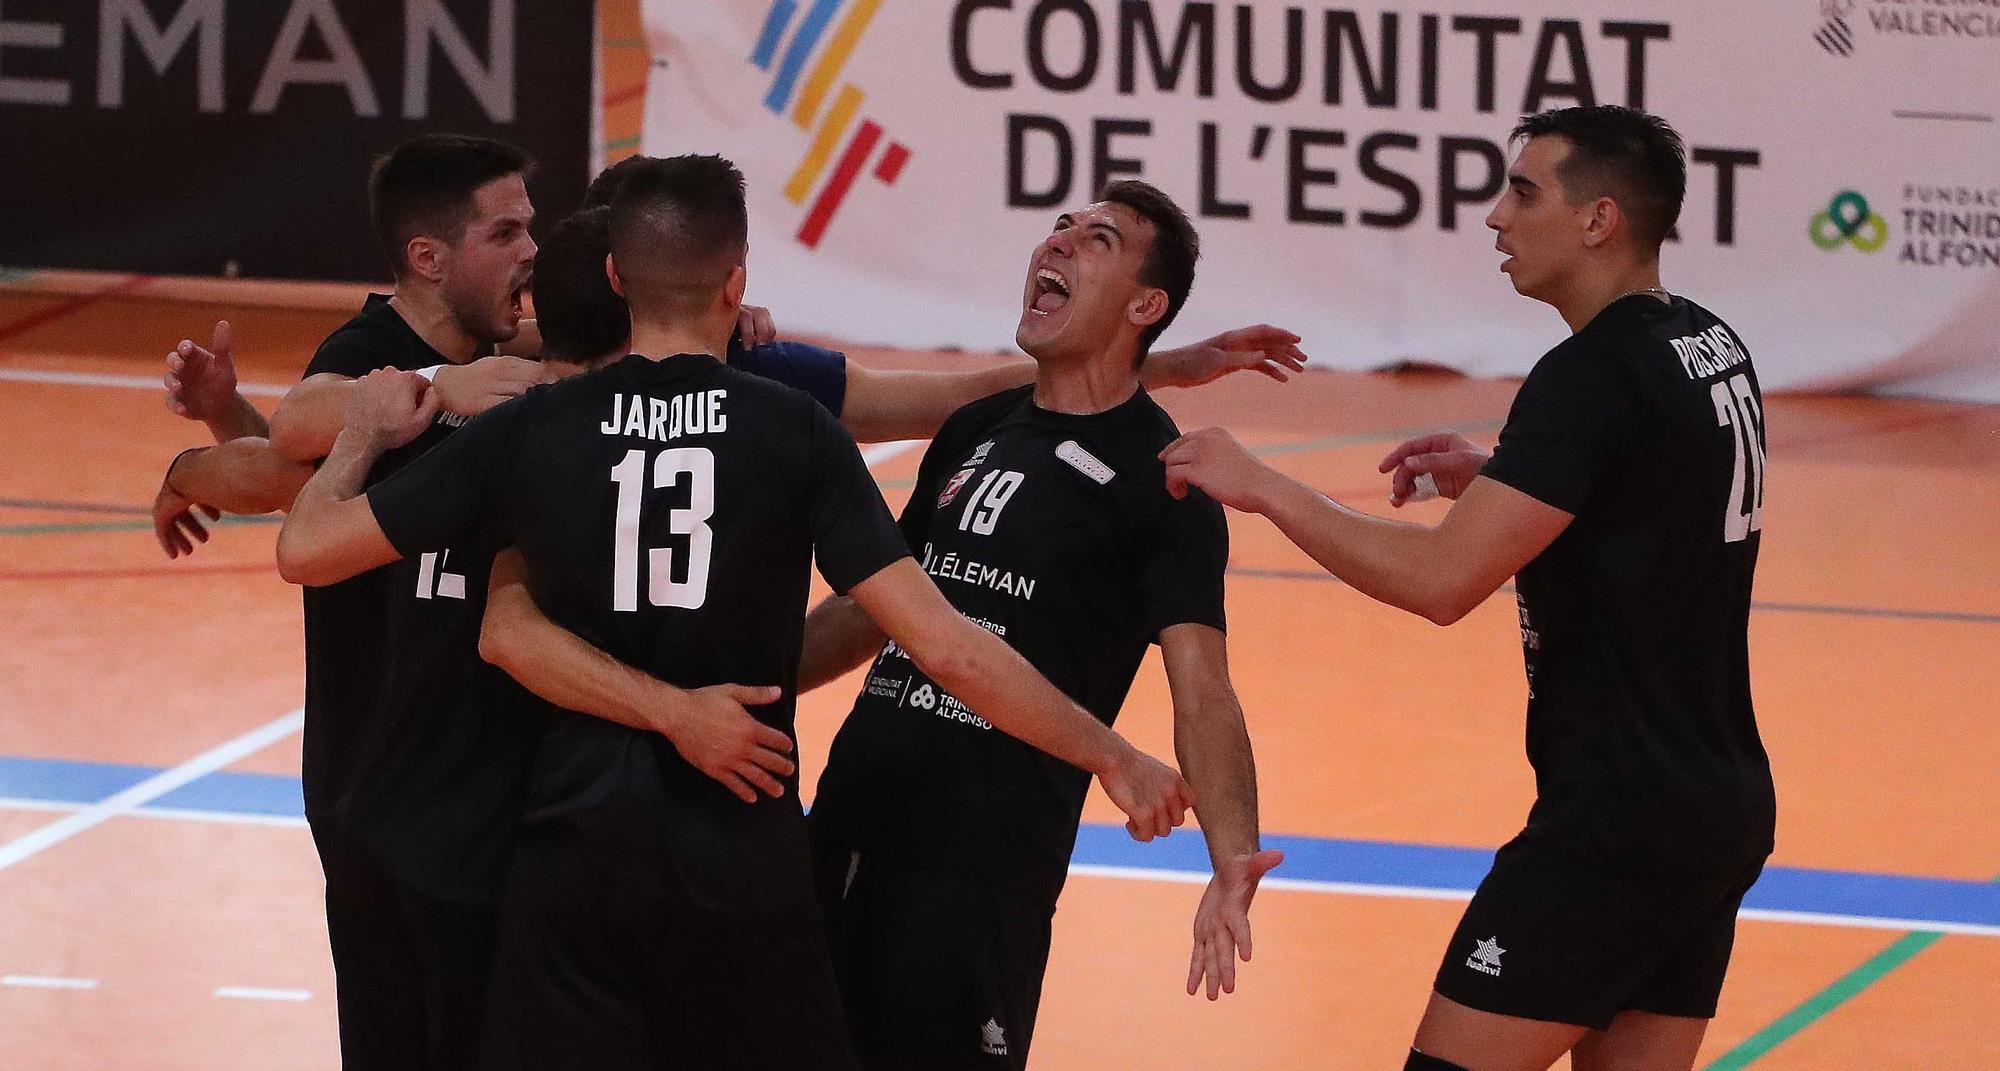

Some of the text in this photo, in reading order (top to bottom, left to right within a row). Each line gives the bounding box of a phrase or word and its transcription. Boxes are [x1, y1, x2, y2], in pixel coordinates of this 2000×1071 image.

[950, 0, 1672, 114] COMUNITAT
[601, 389, 727, 442] JARQUE
[1711, 373, 1767, 543] 20
[611, 447, 715, 611] 13
[958, 469, 1025, 536] 19
[929, 552, 1036, 601] LÉLEMAN
[936, 706, 993, 731] ALFONSO
